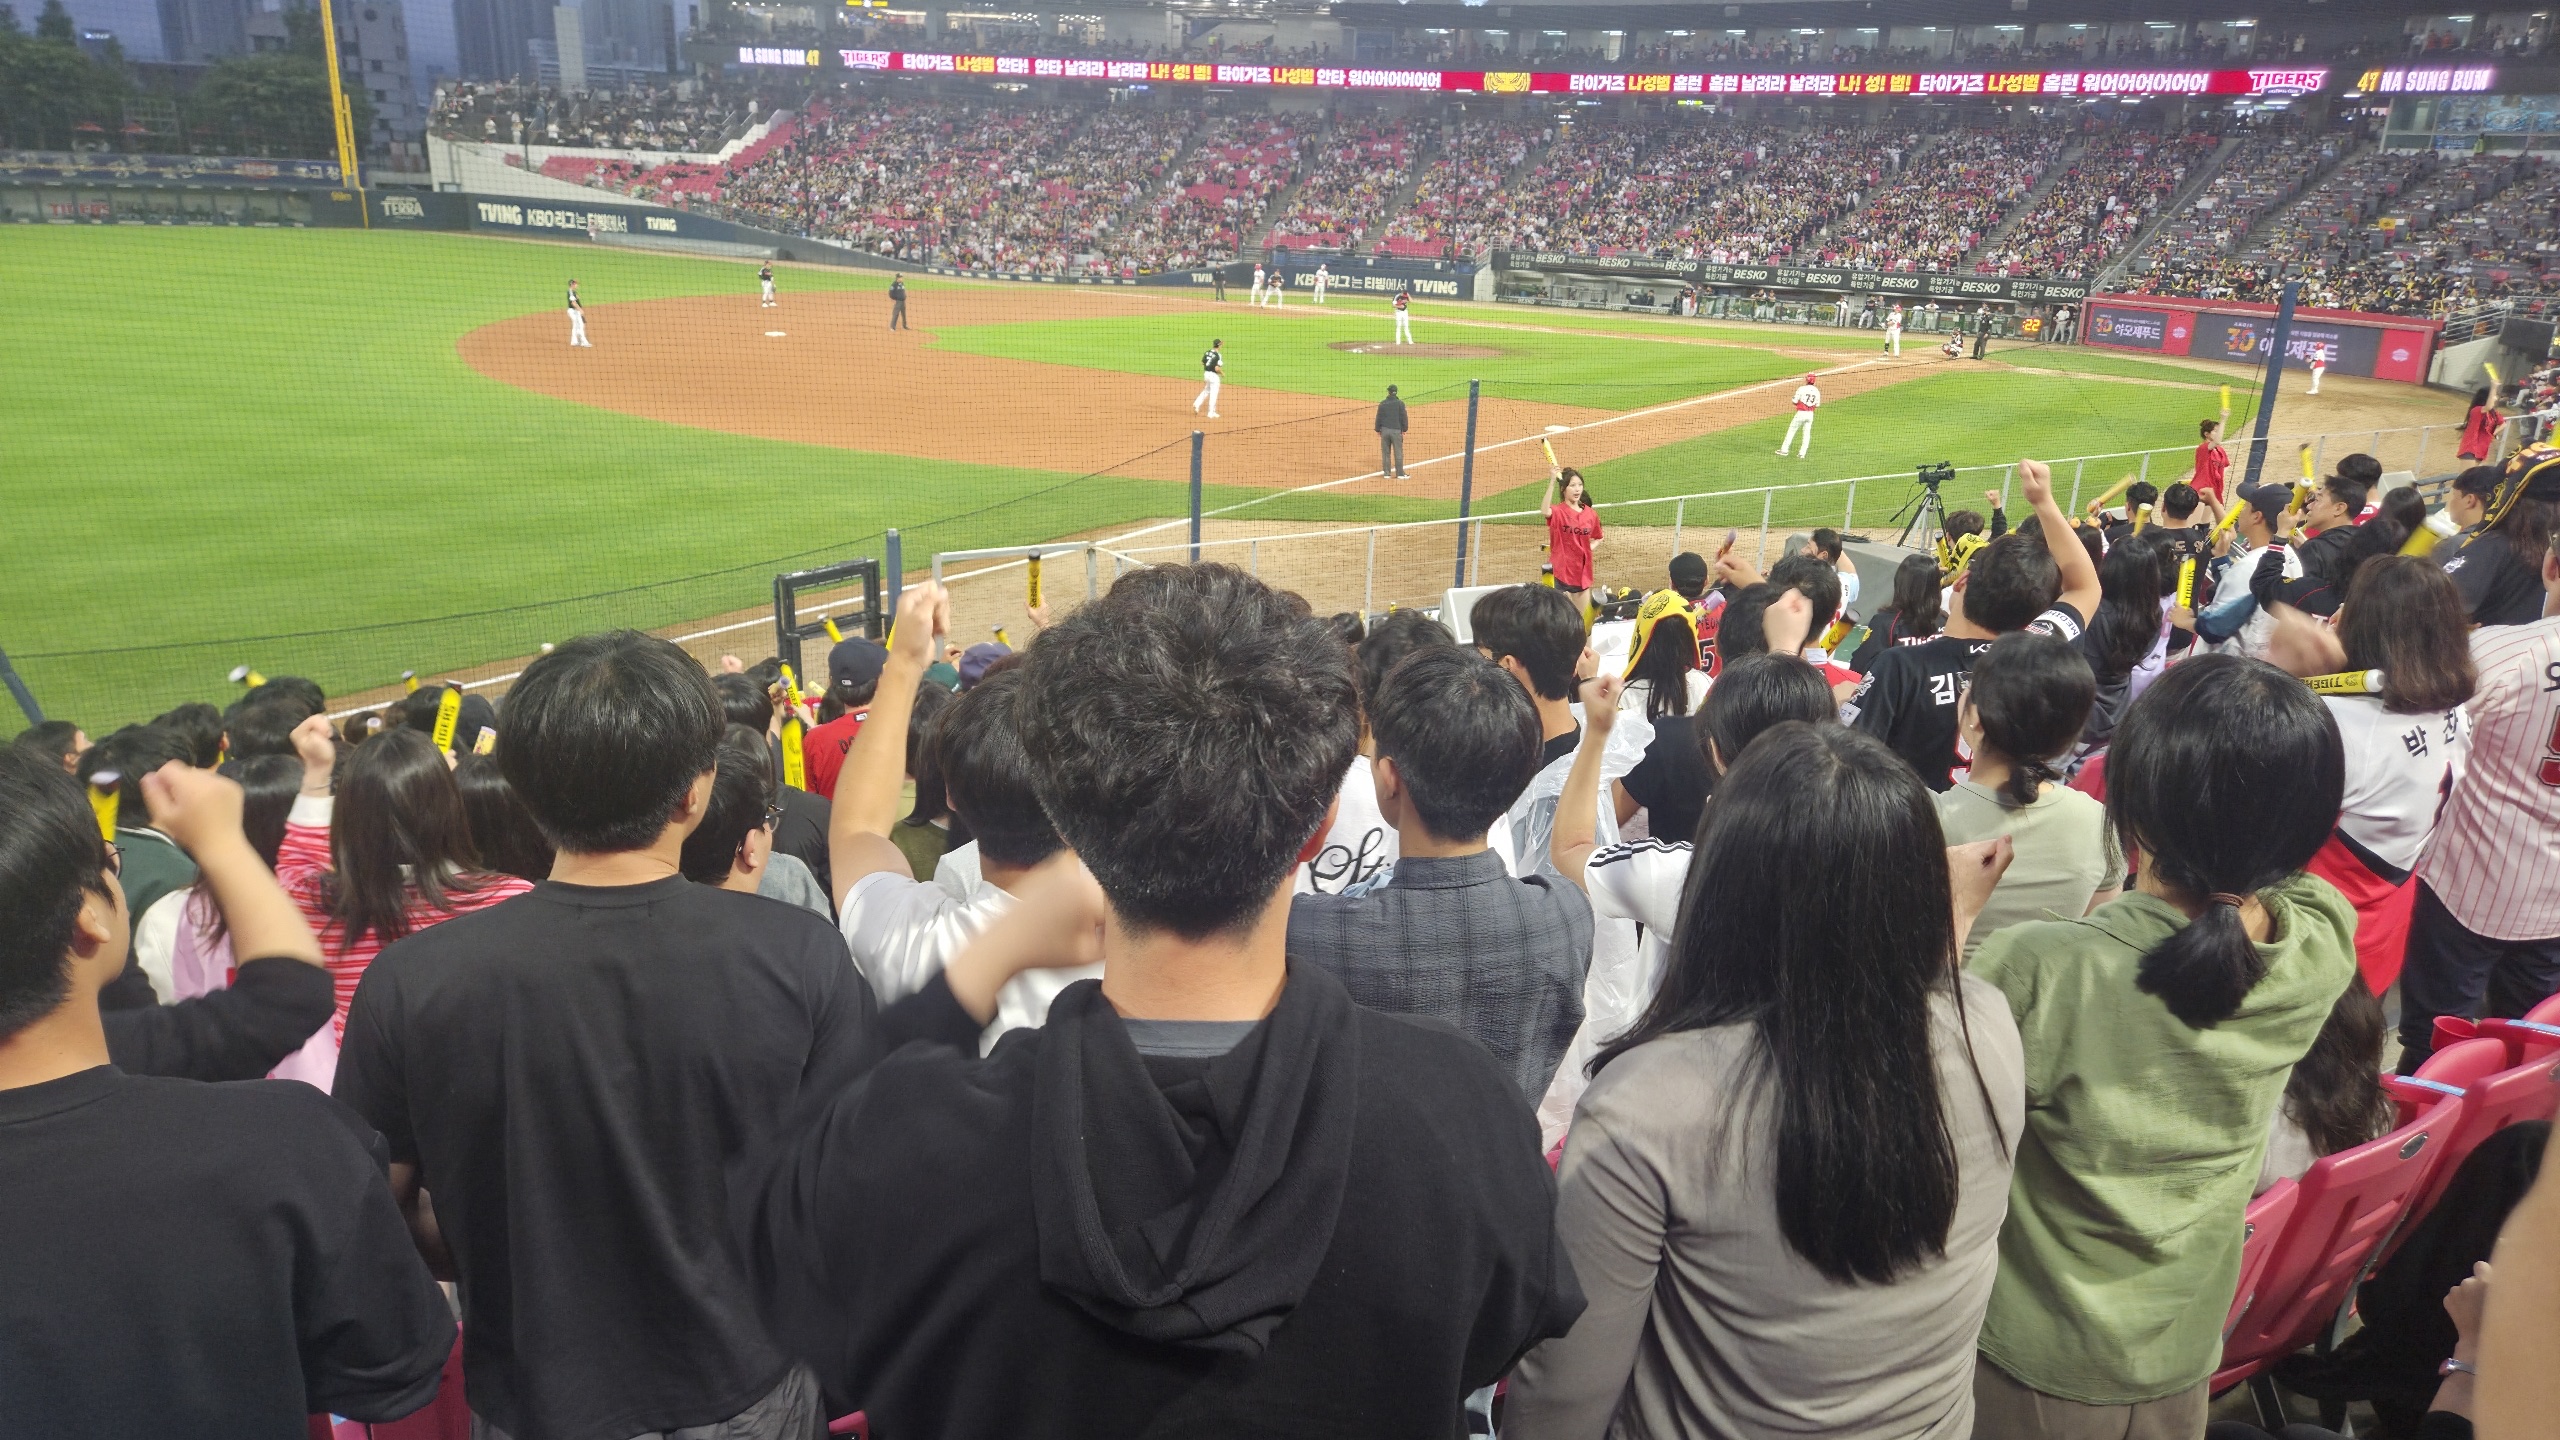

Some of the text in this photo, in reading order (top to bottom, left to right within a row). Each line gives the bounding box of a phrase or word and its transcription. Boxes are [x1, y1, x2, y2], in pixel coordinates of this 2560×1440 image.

[840, 50, 890, 67] TIGERS
[903, 54, 953, 70] 타이거즈
[956, 56, 994, 72] 나성범
[997, 57, 1029, 74] 안타!
[1035, 58, 1062, 75] 안타
[1065, 60, 1105, 76] 날려라
[1108, 62, 1148, 78] 날려라
[1150, 64, 1169, 79] 나!
[1172, 64, 1190, 80] 성!
[1193, 65, 1211, 80] 범!
[1218, 66, 1271, 82] 타이거즈
[1273, 67, 1314, 84] 나성범
[1317, 69, 1346, 85] 안타
[1570, 74, 1625, 91] 타이거즈
[1628, 75, 1671, 91] 나성범
[1674, 75, 1702, 91] 홈런
[1709, 75, 1738, 92] 홈런
[1741, 75, 1786, 92] 날려라
[1790, 75, 1836, 92] 날려라
[1839, 76, 1861, 91] 나!
[1865, 76, 1885, 92] 성!
[1890, 76, 1911, 92] 범!
[1919, 75, 1983, 92] 타이거즈
[1987, 74, 2039, 92] 나성범
[2043, 74, 2078, 92] 홈런
[2248, 71, 2326, 91] TIGERS
[2357, 70, 2490, 91] 47 NA SUNG BUM
[381, 200, 425, 216] TERRA
[478, 203, 522, 225] TVING
[645, 216, 677, 232] TVING
[1536, 254, 1565, 264] BESKO
[1599, 257, 1630, 268] BESKO
[1665, 261, 1697, 272] BESKO
[1192, 272, 1213, 283] TVI
[1734, 269, 1767, 280] BESKO
[1806, 273, 1841, 284] BESKO
[1364, 276, 1408, 291] 티빙에서
[1413, 279, 1458, 295] TVING
[1882, 278, 1919, 289] BESKO
[1961, 281, 2000, 293] BESKO
[2044, 286, 2085, 299] BESKO
[2115, 324, 2160, 339] 아모제푸드
[1698, 638, 1714, 673] 5
[787, 686, 799, 707] TIGER
[1930, 673, 1955, 705] 김
